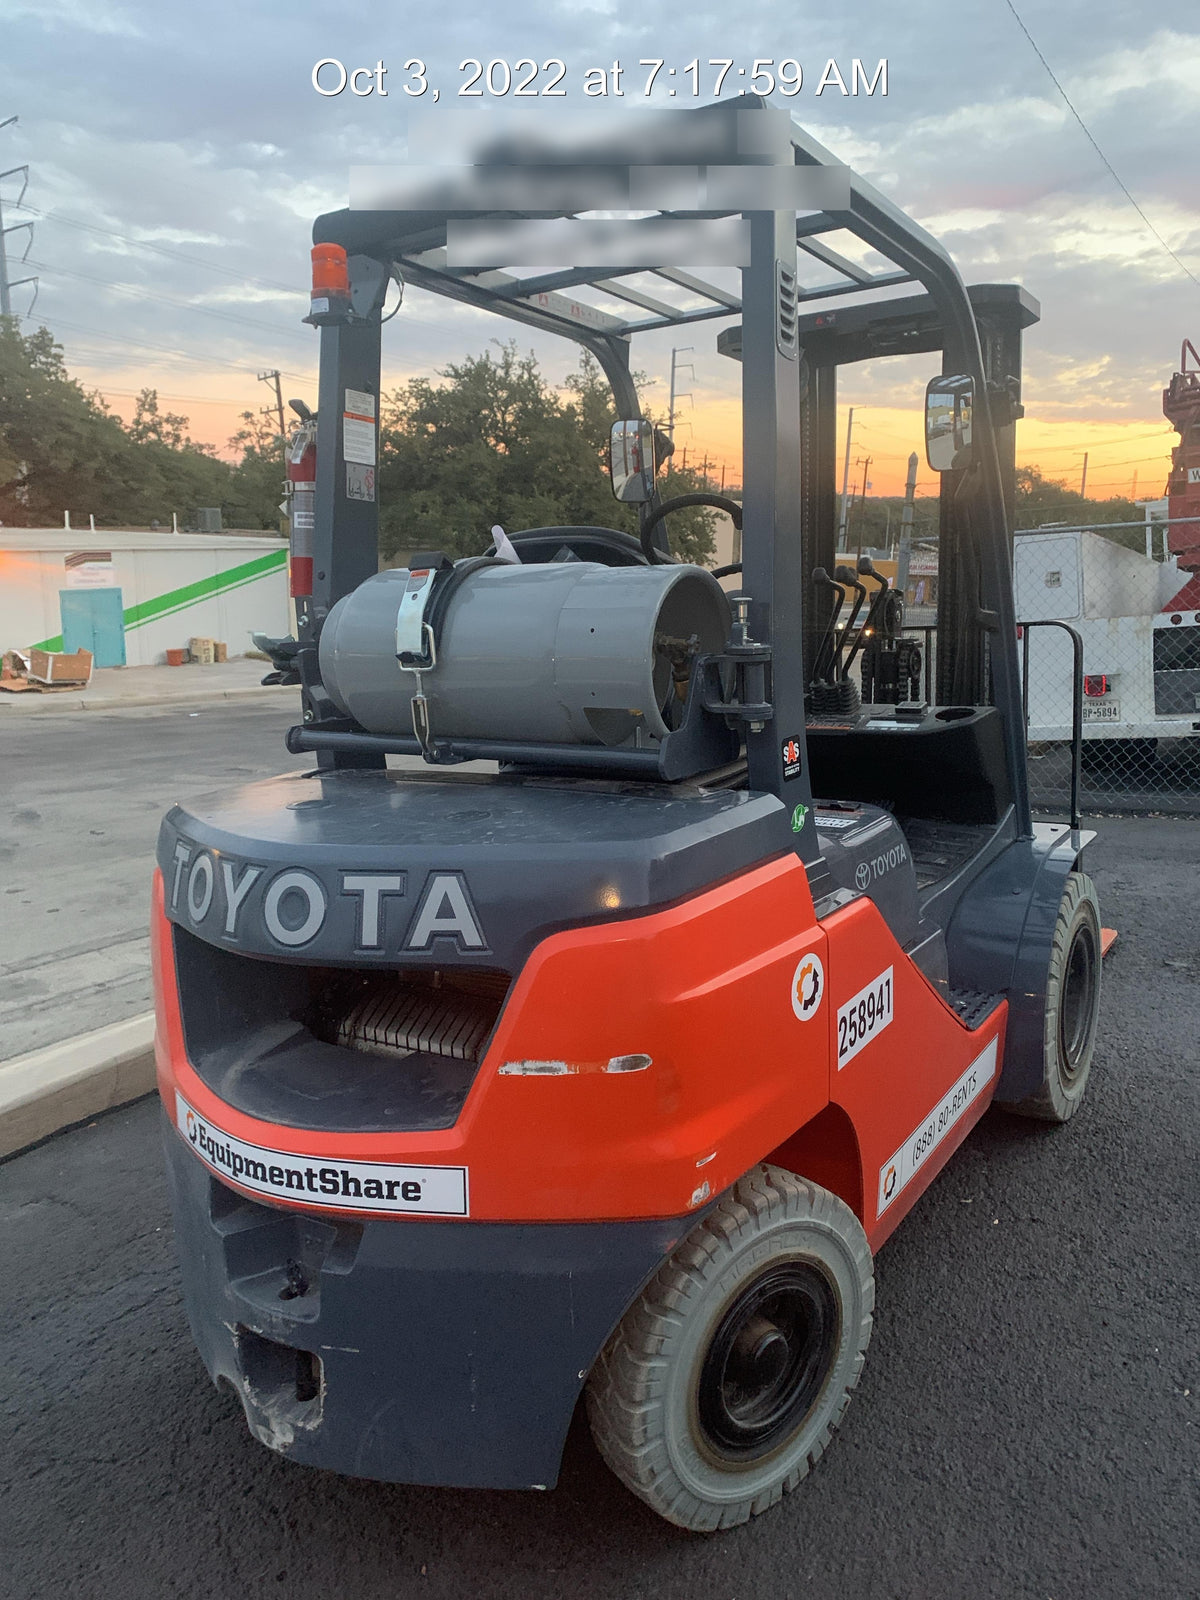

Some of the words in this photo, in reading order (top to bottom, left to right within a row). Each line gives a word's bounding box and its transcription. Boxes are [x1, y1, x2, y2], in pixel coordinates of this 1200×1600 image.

[783, 741, 799, 764] SAS
[172, 842, 484, 947] TOYOTA
[870, 843, 907, 880] TOYOTA
[838, 977, 891, 1059] 258941
[912, 1120, 936, 1167] (888)
[938, 1070, 977, 1133] 80-RENTS
[197, 1123, 422, 1203] EquipmentShare
